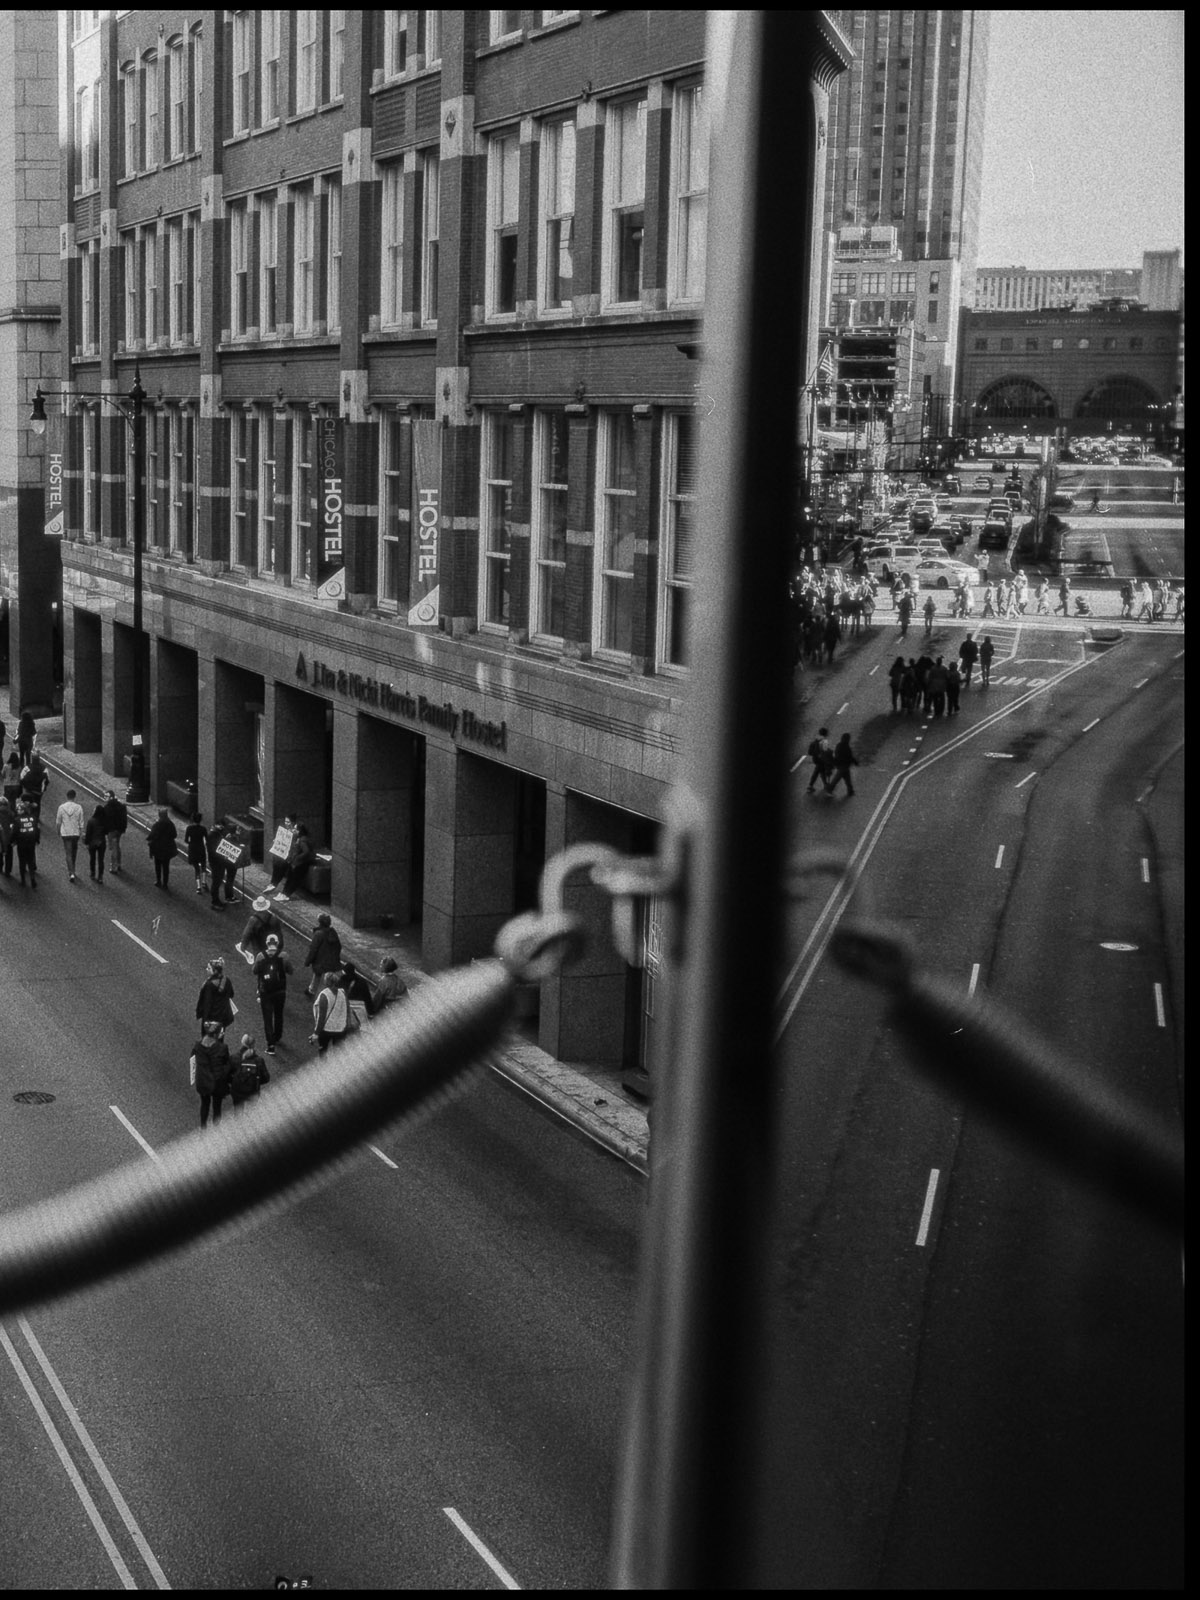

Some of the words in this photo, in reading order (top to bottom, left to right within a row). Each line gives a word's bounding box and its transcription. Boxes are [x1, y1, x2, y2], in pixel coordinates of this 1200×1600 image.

[49, 453, 62, 510] HOSTEL
[324, 419, 336, 479] CHICAGO
[324, 478, 342, 562] HOSTEL
[418, 488, 439, 582] HOSTEL
